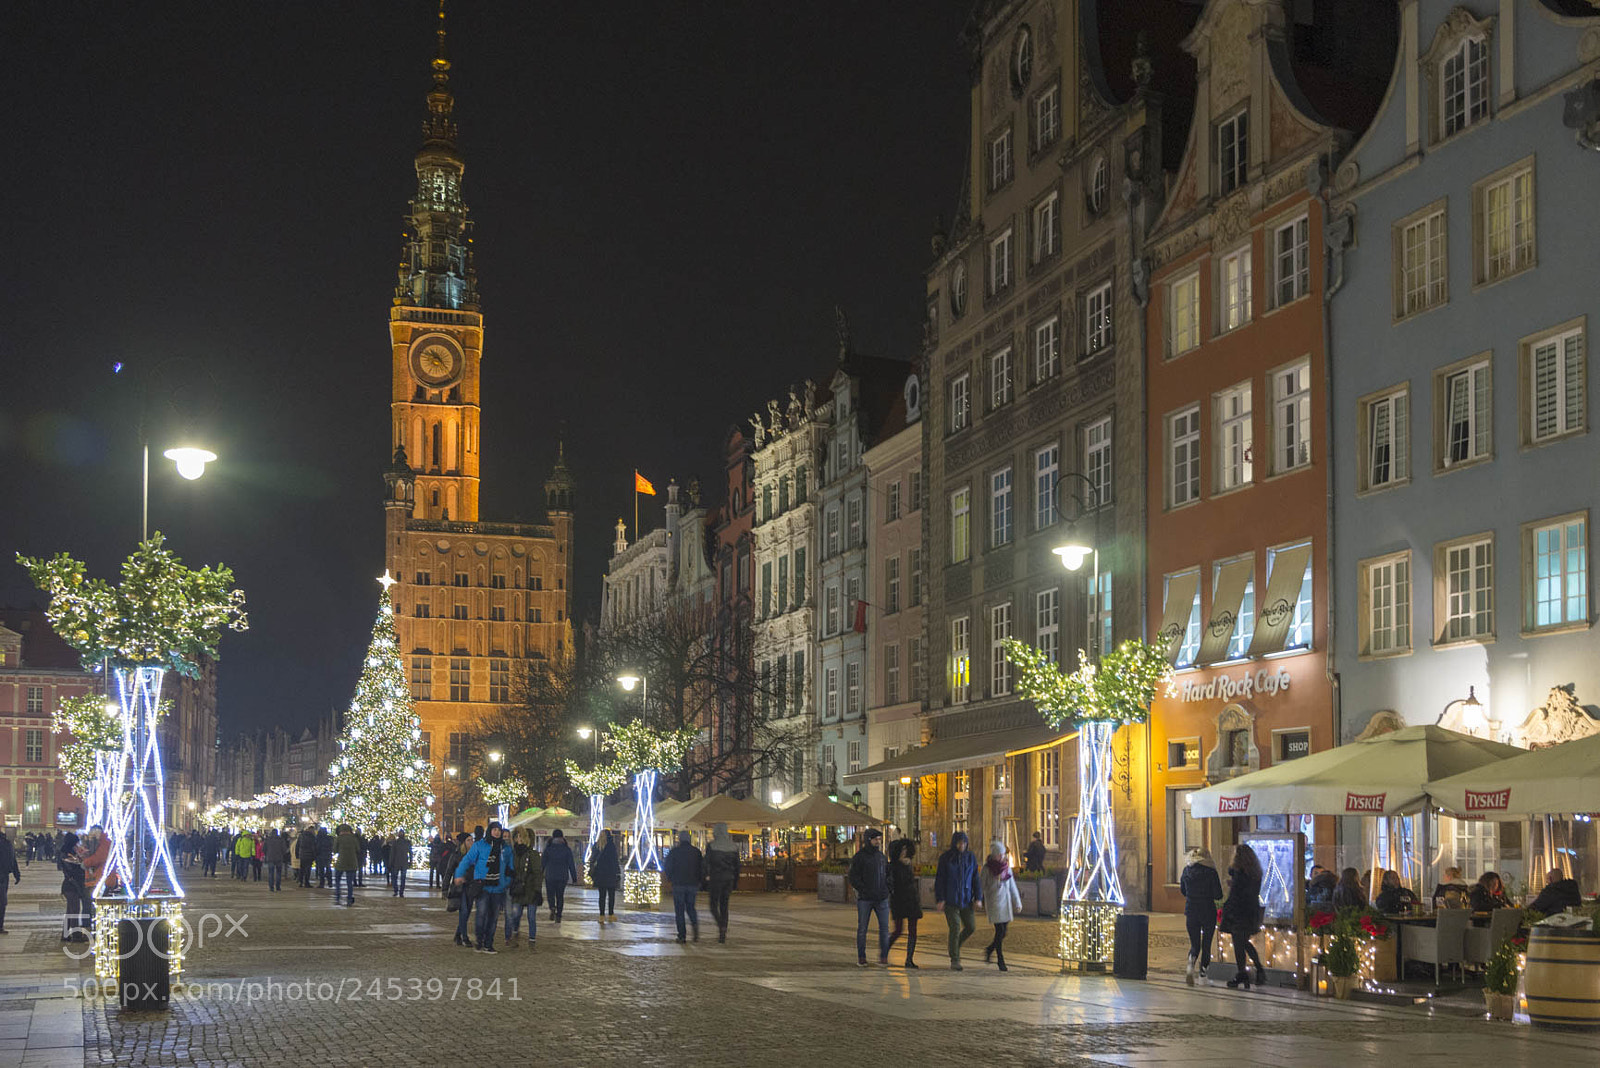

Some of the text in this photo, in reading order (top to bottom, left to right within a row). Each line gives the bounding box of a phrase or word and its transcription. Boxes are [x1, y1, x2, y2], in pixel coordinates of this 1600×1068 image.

[1182, 666, 1291, 703] Hard Rock Cafe
[1288, 741, 1309, 752] SHOP
[1220, 797, 1249, 811] TYSKIE
[1348, 795, 1383, 810] TYSKIE
[1467, 792, 1507, 808] TYSKIE
